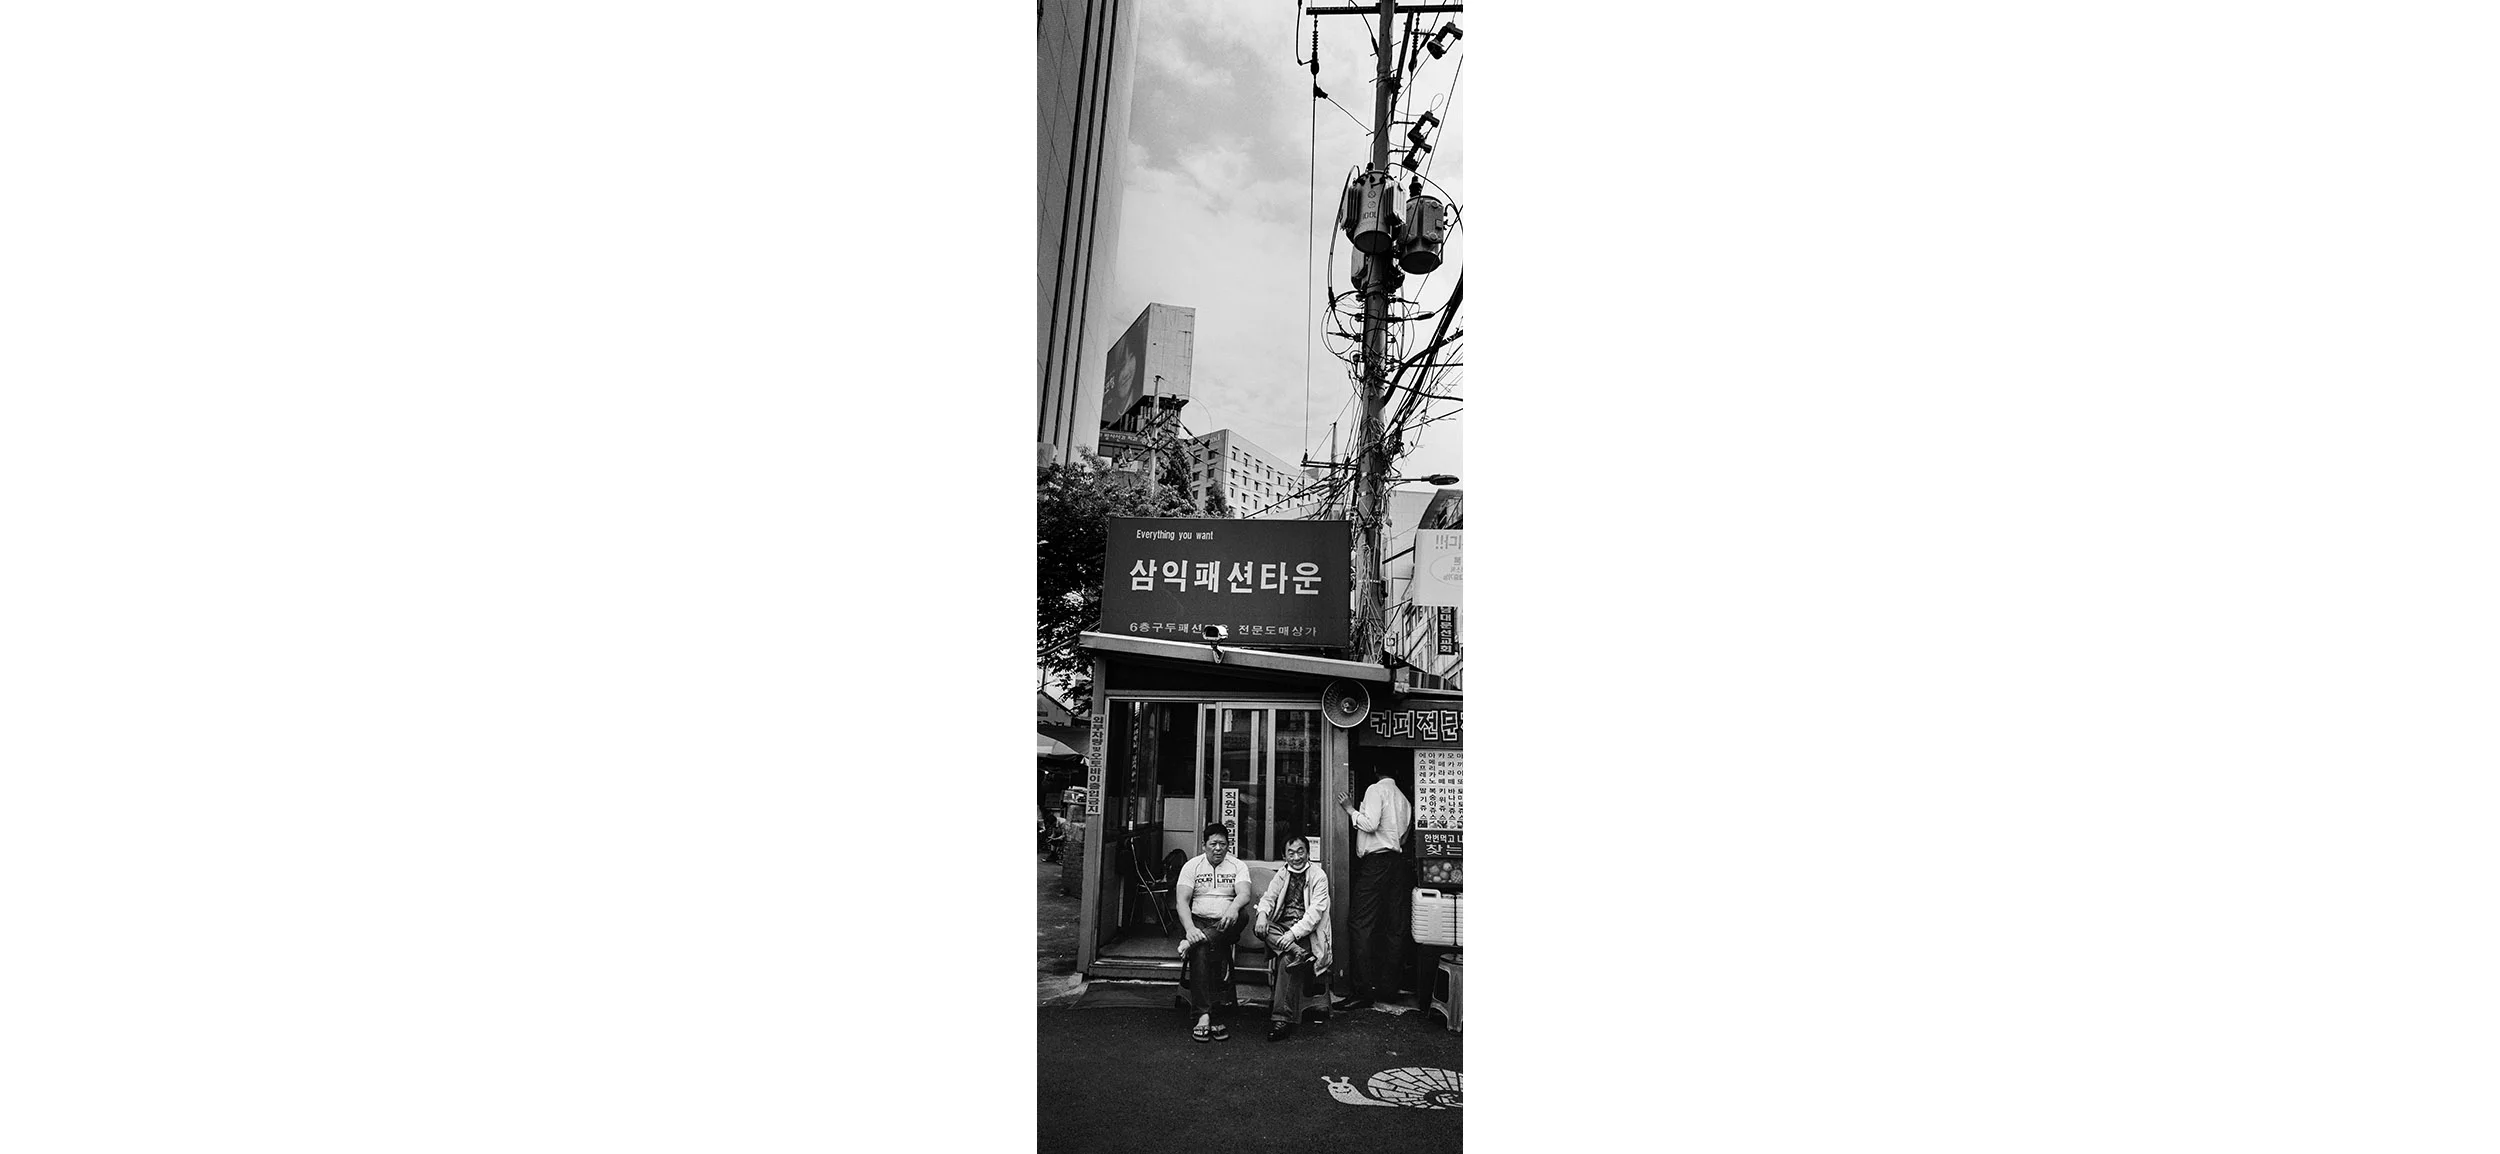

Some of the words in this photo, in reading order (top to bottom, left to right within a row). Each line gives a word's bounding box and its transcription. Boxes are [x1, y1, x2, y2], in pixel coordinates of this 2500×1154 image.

[1136, 529, 1175, 541] Everything
[1178, 531, 1193, 541] you
[1196, 531, 1214, 541] want
[1129, 559, 1322, 595] 삼익패션타운
[1129, 621, 1229, 635] 6층구두패션
[1238, 624, 1317, 637] 전문도매상가
[1370, 709, 1463, 742] 커피전문
[1224, 791, 1236, 818] 직원외
